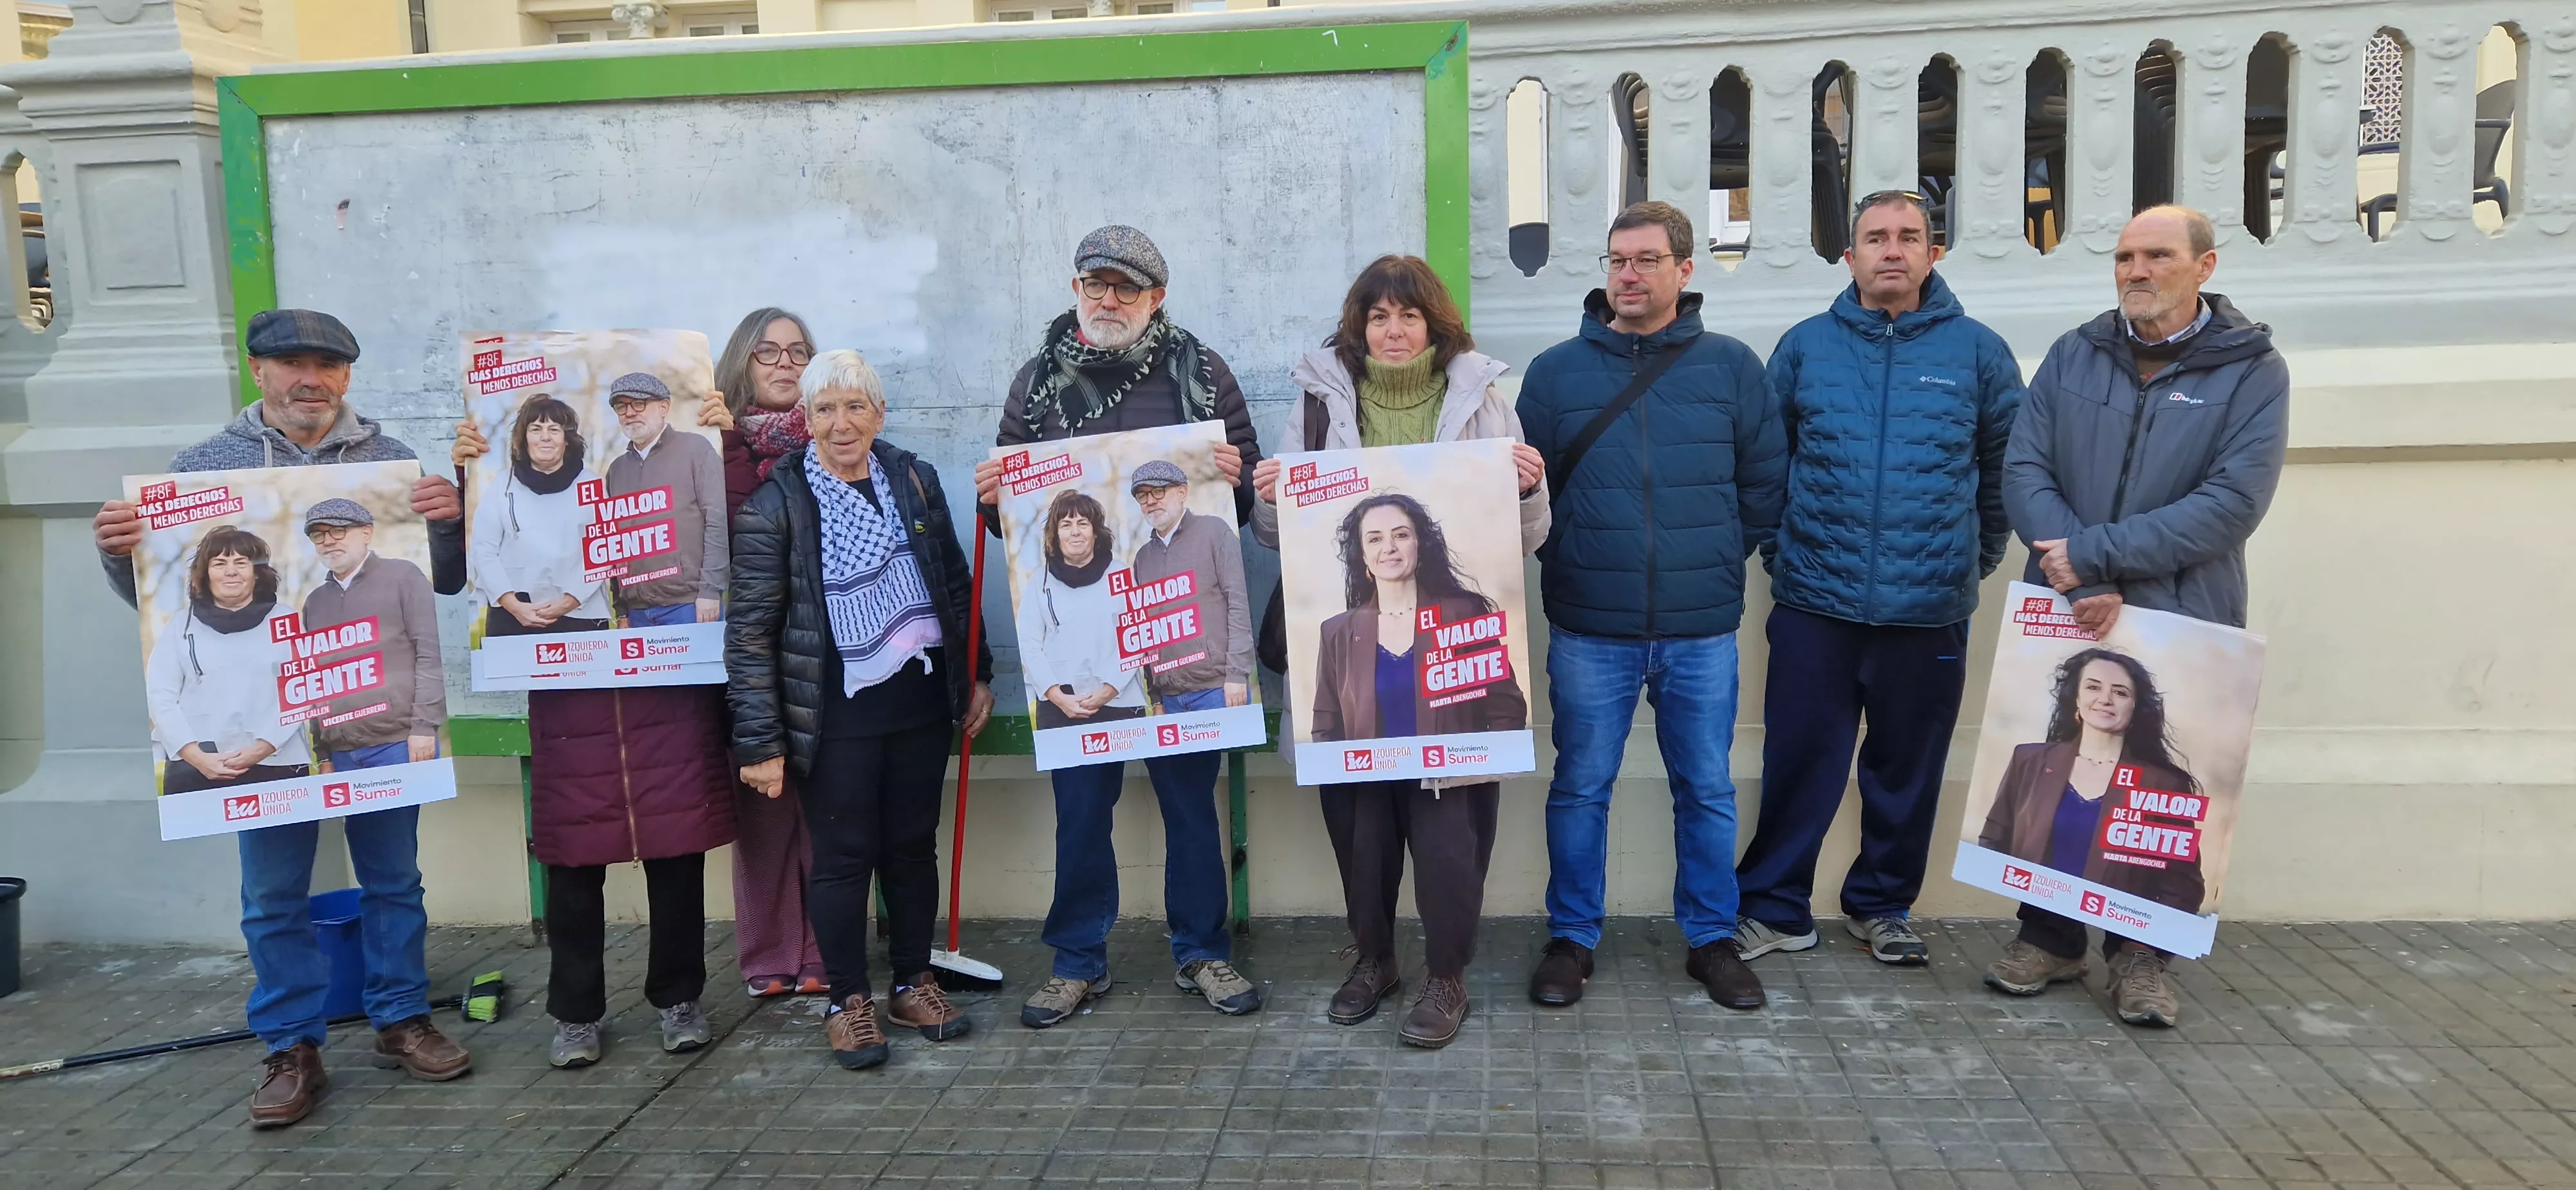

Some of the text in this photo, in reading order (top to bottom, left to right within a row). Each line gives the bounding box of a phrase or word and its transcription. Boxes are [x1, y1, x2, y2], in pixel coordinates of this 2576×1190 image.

[477, 352, 498, 368] #8F
[493, 358, 542, 378] DERECHOS
[483, 369, 554, 393] MENOS DERECHAS
[1006, 453, 1026, 471] #8F
[1021, 455, 1068, 478] DERECHOS
[1014, 465, 1080, 495] MENOS DERECHAS
[1293, 464, 1314, 482] #8F
[1307, 469, 1355, 490] DERECHOS
[144, 483, 173, 502] #8F
[164, 488, 226, 511] DERECHOS
[582, 483, 600, 503] EL
[1298, 479, 1367, 505] MENOS DERECHAS
[154, 499, 240, 528] MENOS DERECHAS
[598, 490, 667, 522] VALOR
[588, 522, 617, 538] DE LA
[589, 524, 670, 565] GENTE
[585, 572, 607, 583] PILAR
[621, 567, 677, 586] VICENTE GUERRERO
[1112, 572, 1129, 593] EL
[1128, 575, 1191, 610] VALOR
[2025, 599, 2050, 612] #8F
[1121, 609, 1147, 627] DE LA
[1420, 609, 1437, 630] EL
[2038, 614, 2076, 625] DERECH
[275, 618, 296, 639] EL
[1122, 609, 1197, 652] GENTE
[1435, 616, 1501, 648] VALOR
[2025, 625, 2055, 636] MENOS
[294, 621, 374, 658] VALOR
[567, 640, 609, 652] IZQUIERDA
[647, 636, 690, 645] Movimiento
[568, 652, 593, 663] UNIDA
[648, 644, 690, 656] Sumar
[1426, 648, 1453, 665] DE LA
[284, 657, 316, 677] DE LA
[1121, 659, 1141, 671] PILAR
[1153, 652, 1205, 673] VICENTE GUERRERO
[1426, 650, 1503, 692] GENTE
[285, 657, 377, 704] GENTE
[281, 712, 306, 725] PILAR
[323, 703, 387, 727] VICENTE GUERRERO
[1110, 727, 1147, 741] IZQUIERDA
[1181, 721, 1221, 731] Movimiento
[1182, 729, 1222, 742] Sumar
[1111, 740, 1134, 751] UNIDA
[1373, 747, 1412, 758] IZQUIERDA
[1447, 744, 1489, 753] Movimiento
[1374, 759, 1397, 770] UNIDA
[1448, 753, 1490, 764] Sumar
[354, 778, 402, 789] Movimiento
[2117, 768, 2134, 786] EL
[261, 788, 309, 804] IZQUIERDA
[355, 787, 402, 801] Sumar
[263, 803, 292, 816] UNIDA
[2130, 789, 2201, 818] VALOR
[2112, 808, 2141, 822] DE LA
[2107, 821, 2193, 856] GENTE
[2031, 884, 2054, 900] UNIDA
[2033, 874, 2072, 894] IZQUIERDA
[2106, 907, 2150, 929] Sumar
[2108, 900, 2152, 920] Movimiento
